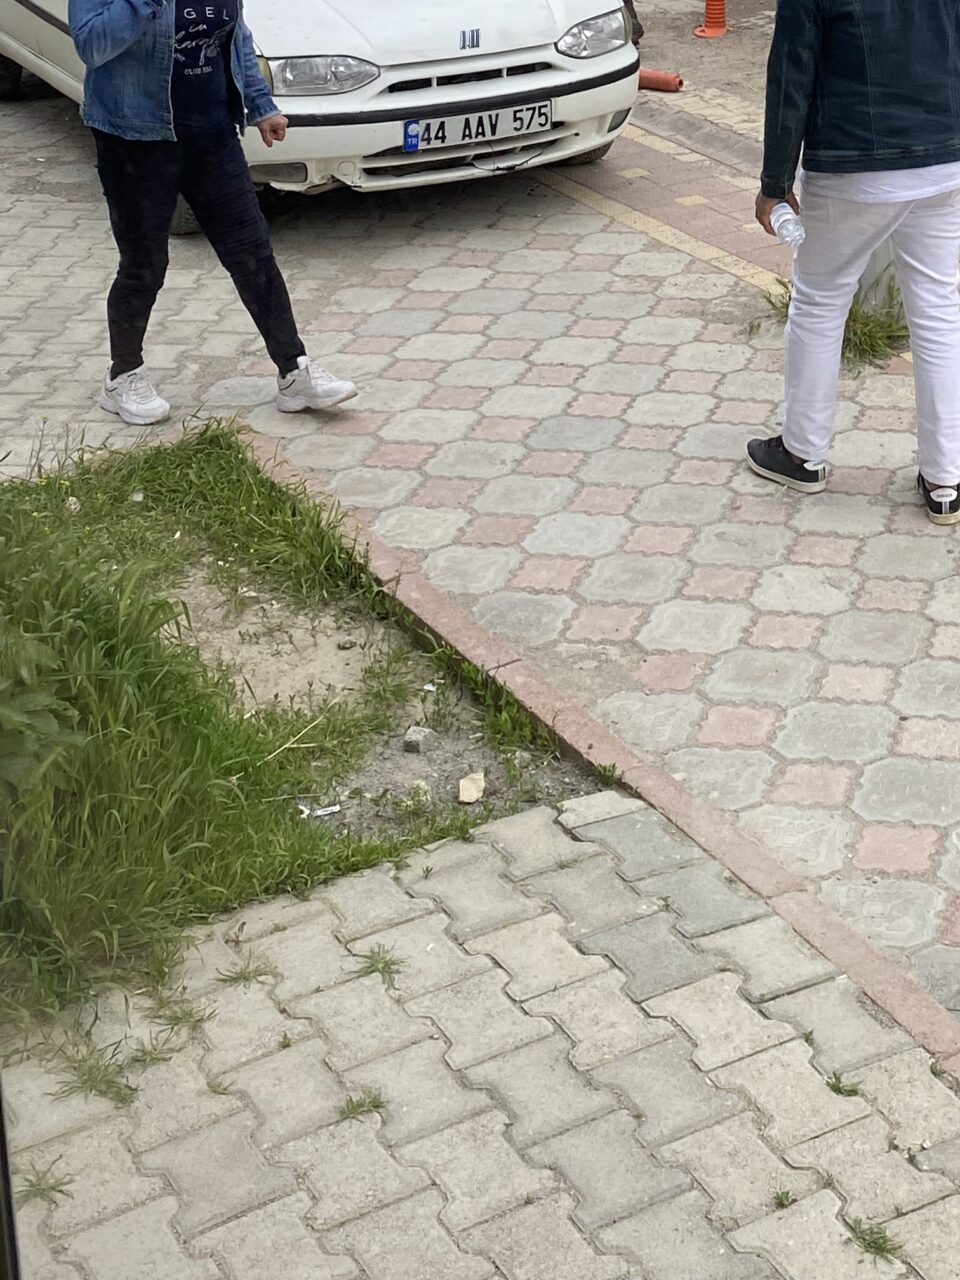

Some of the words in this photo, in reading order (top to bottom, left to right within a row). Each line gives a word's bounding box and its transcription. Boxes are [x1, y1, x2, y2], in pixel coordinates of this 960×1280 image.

[407, 137, 418, 145] TR
[421, 121, 447, 145] 44
[461, 113, 500, 141] AAV
[513, 104, 549, 131] 575
